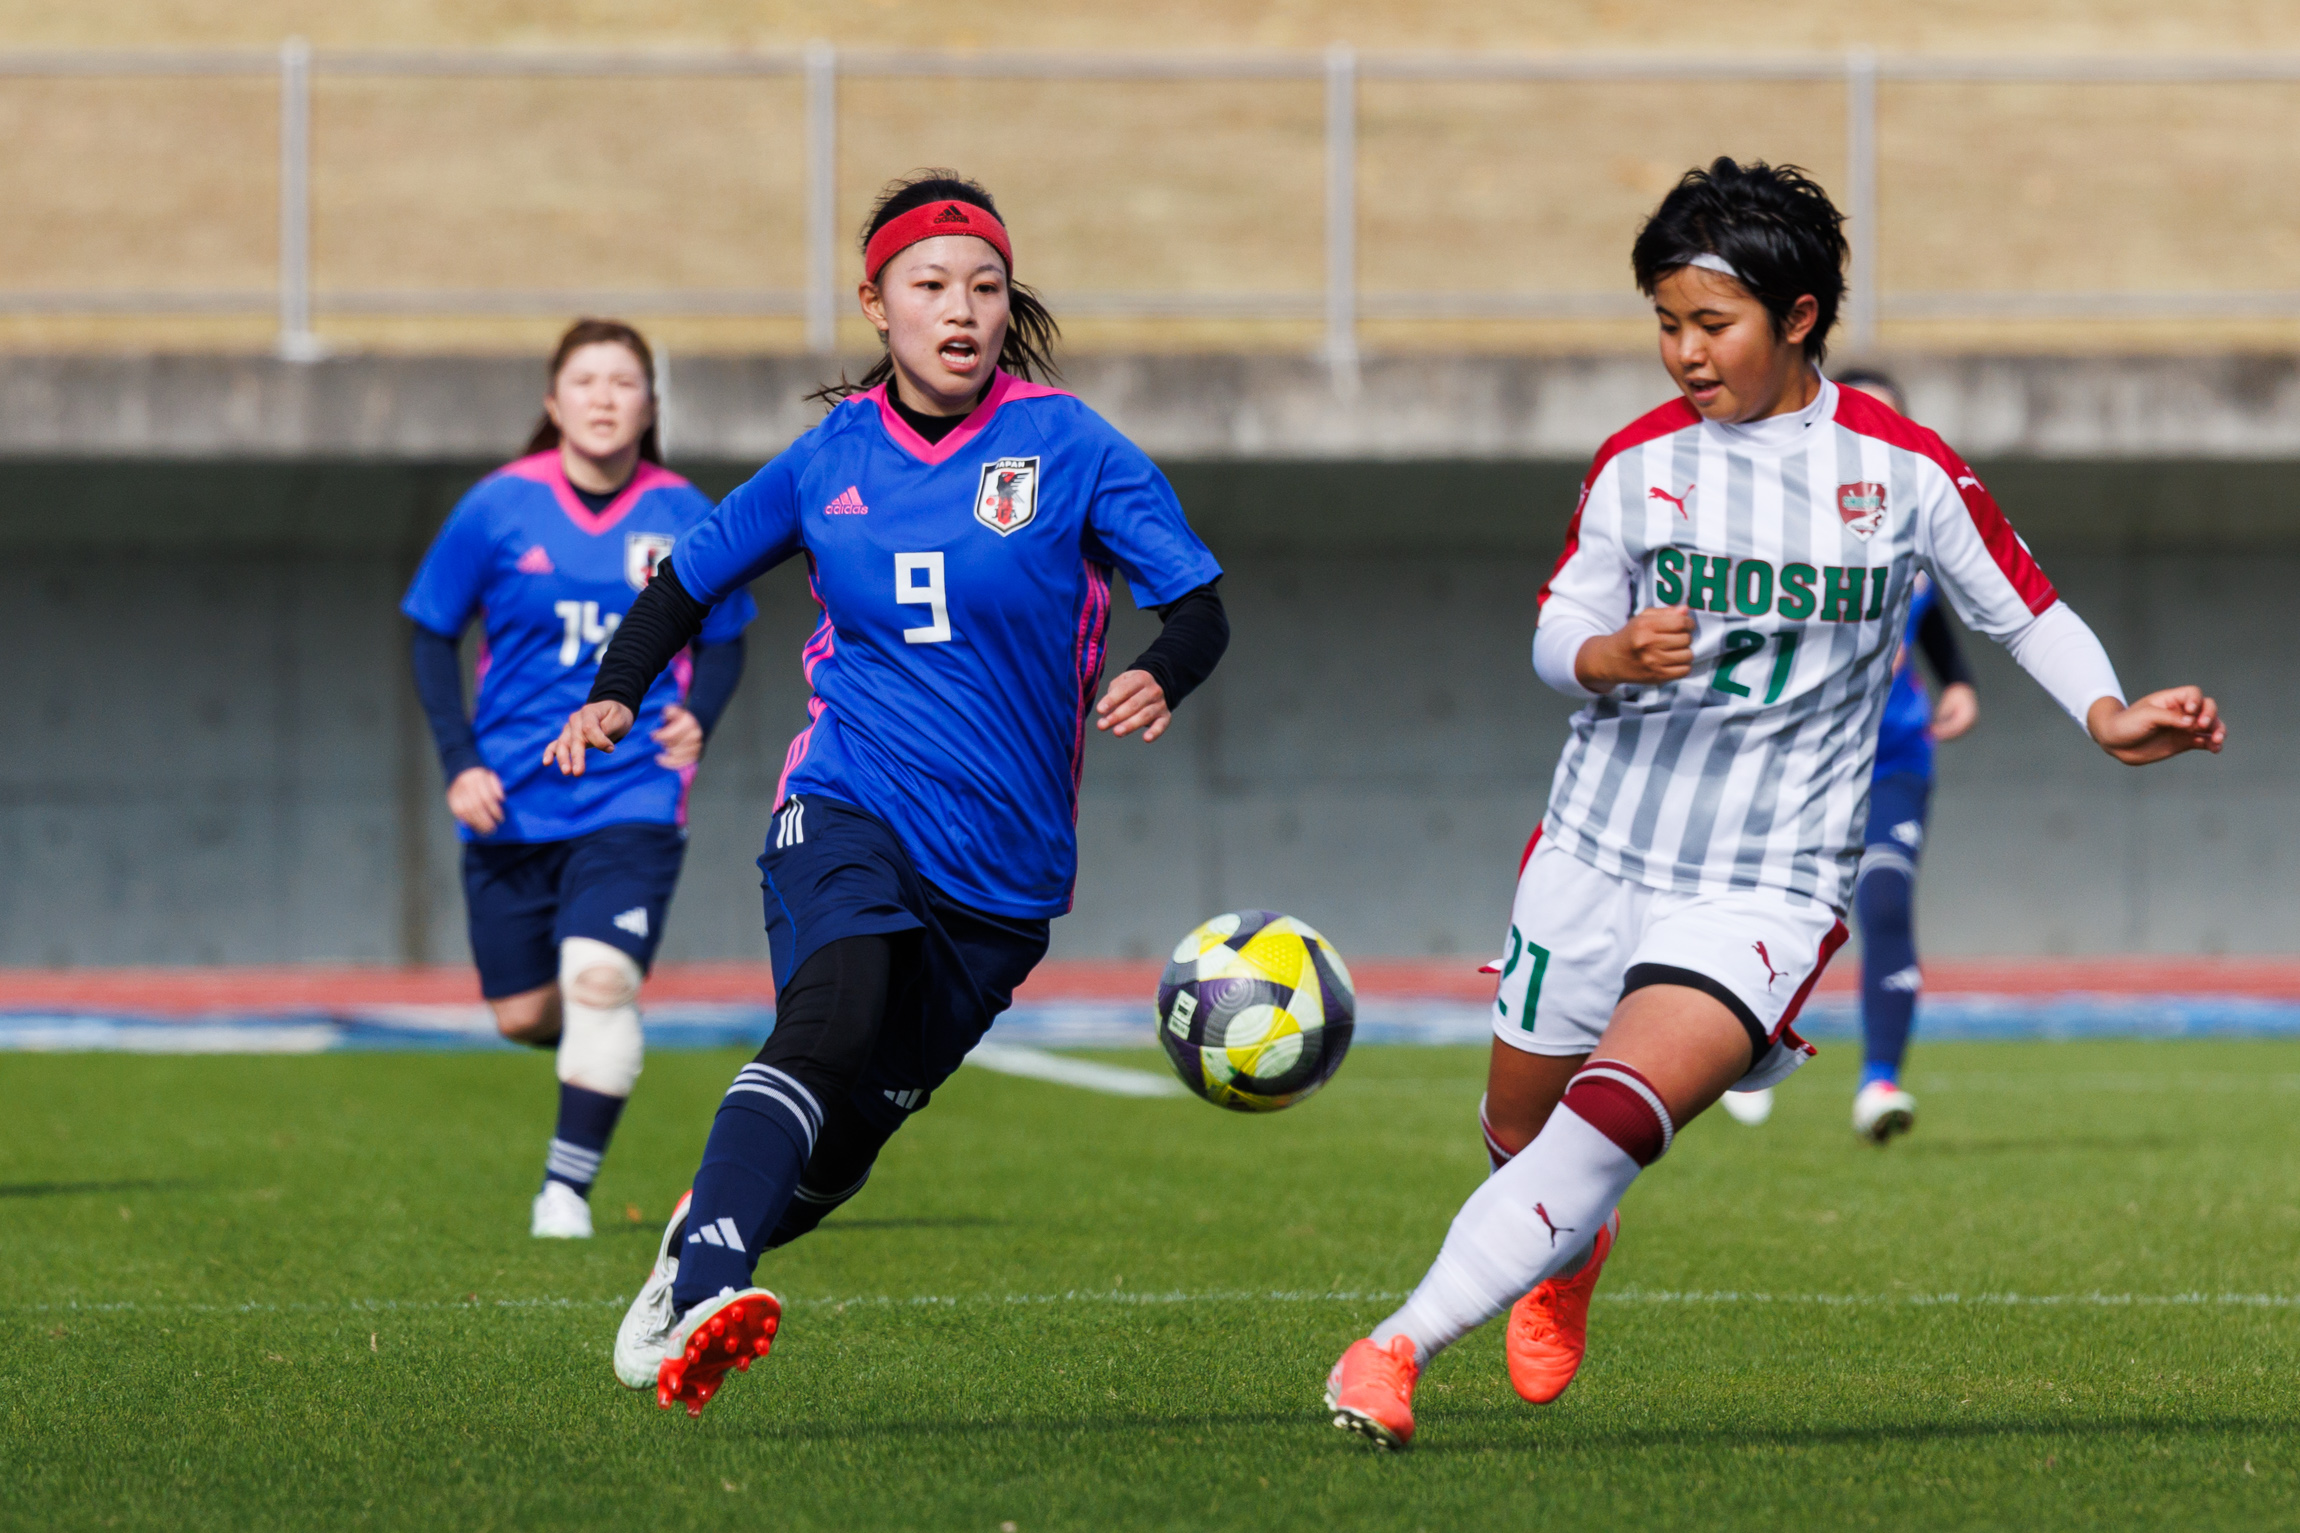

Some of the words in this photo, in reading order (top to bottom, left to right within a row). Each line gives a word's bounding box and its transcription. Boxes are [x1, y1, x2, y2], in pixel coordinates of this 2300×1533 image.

[995, 461, 1025, 469] JAPAN
[825, 503, 869, 515] adidas
[992, 508, 1018, 519] JFA
[895, 552, 952, 644] 9
[1656, 547, 1888, 623] SHOSHI
[1711, 629, 1798, 704] 21
